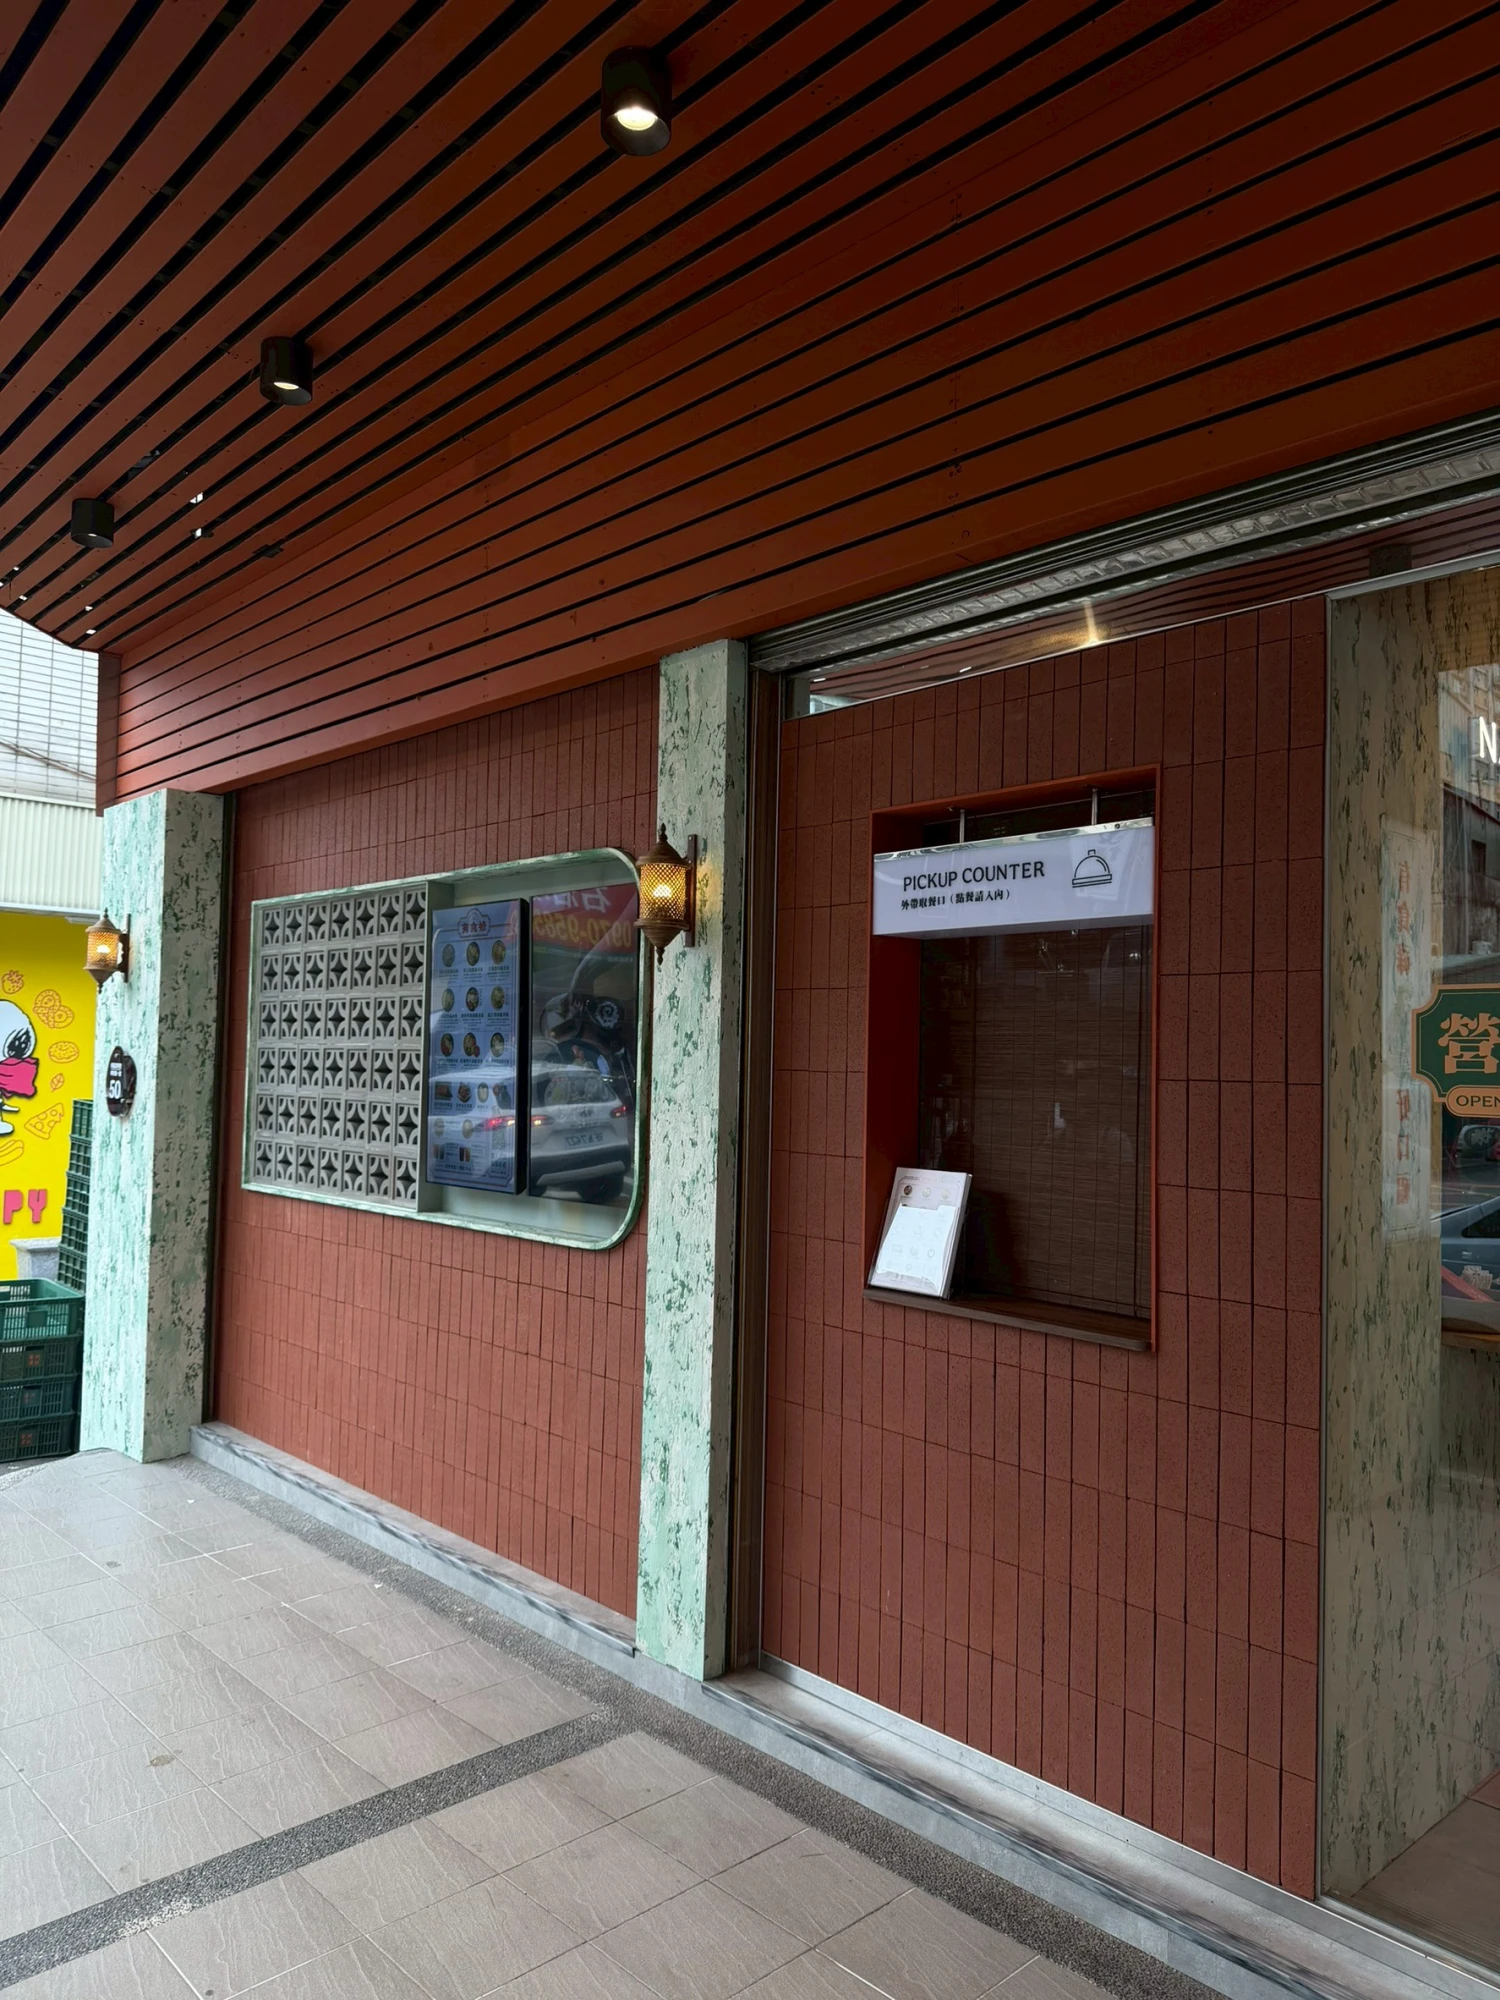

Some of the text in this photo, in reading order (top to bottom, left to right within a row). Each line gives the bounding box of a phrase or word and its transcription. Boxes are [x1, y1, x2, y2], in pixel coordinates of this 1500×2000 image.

[1479, 716, 1500, 764] N
[903, 861, 1045, 891] PICKUP COUNTER
[109, 1080, 121, 1099] 50
[3, 1189, 48, 1224] PY
